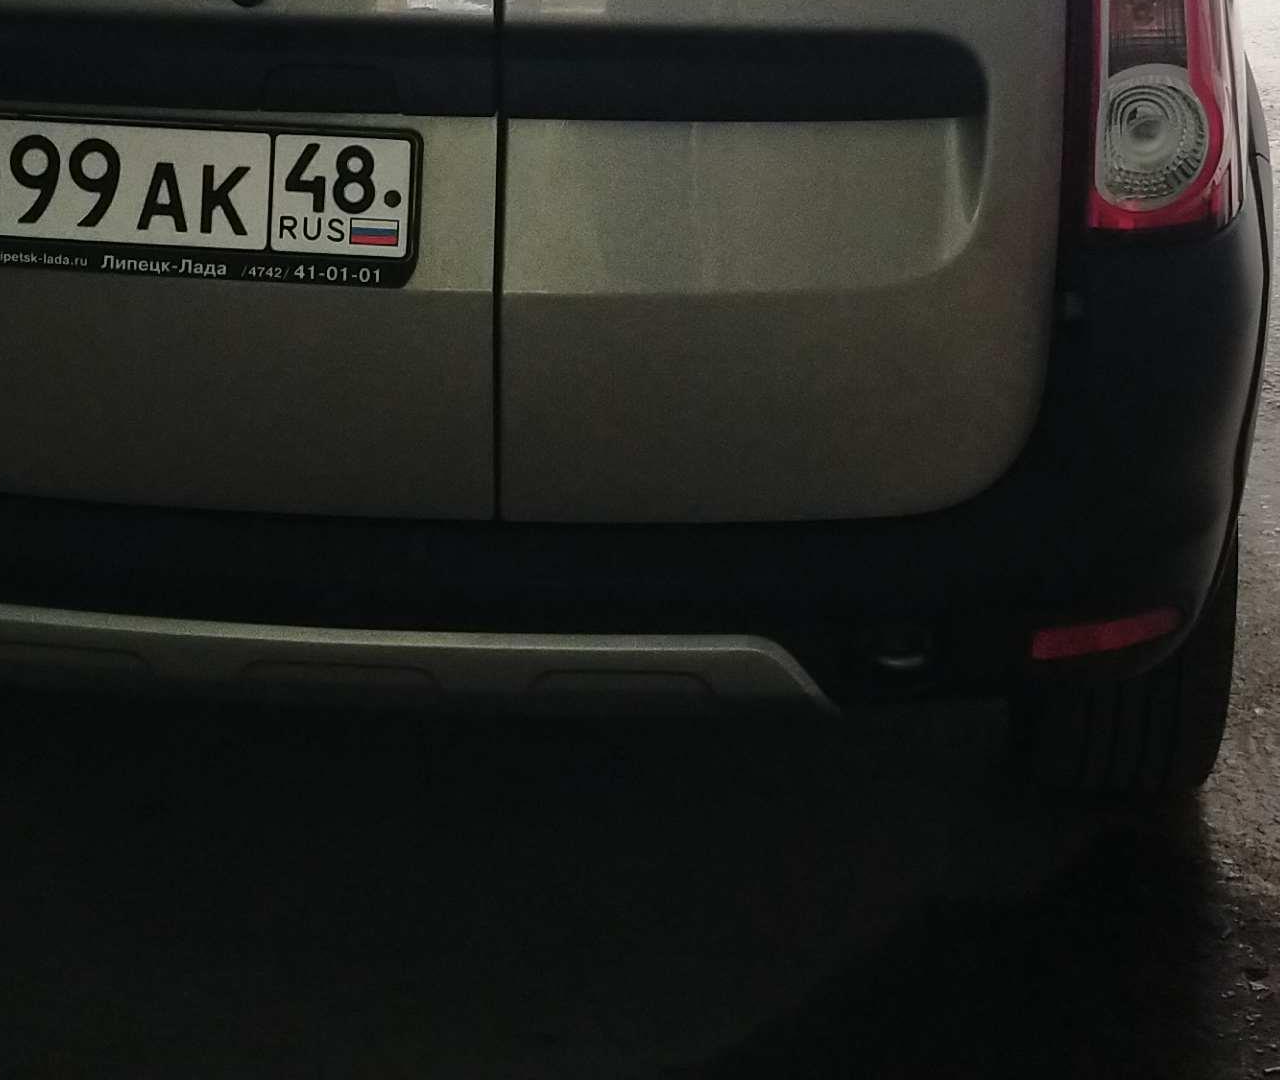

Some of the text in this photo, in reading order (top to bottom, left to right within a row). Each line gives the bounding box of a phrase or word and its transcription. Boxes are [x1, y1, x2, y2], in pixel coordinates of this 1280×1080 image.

[284, 142, 376, 215] 48
[278, 215, 346, 243] RUS
[100, 255, 228, 277] Липецк-Лада
[293, 264, 381, 283] 41-01-01
